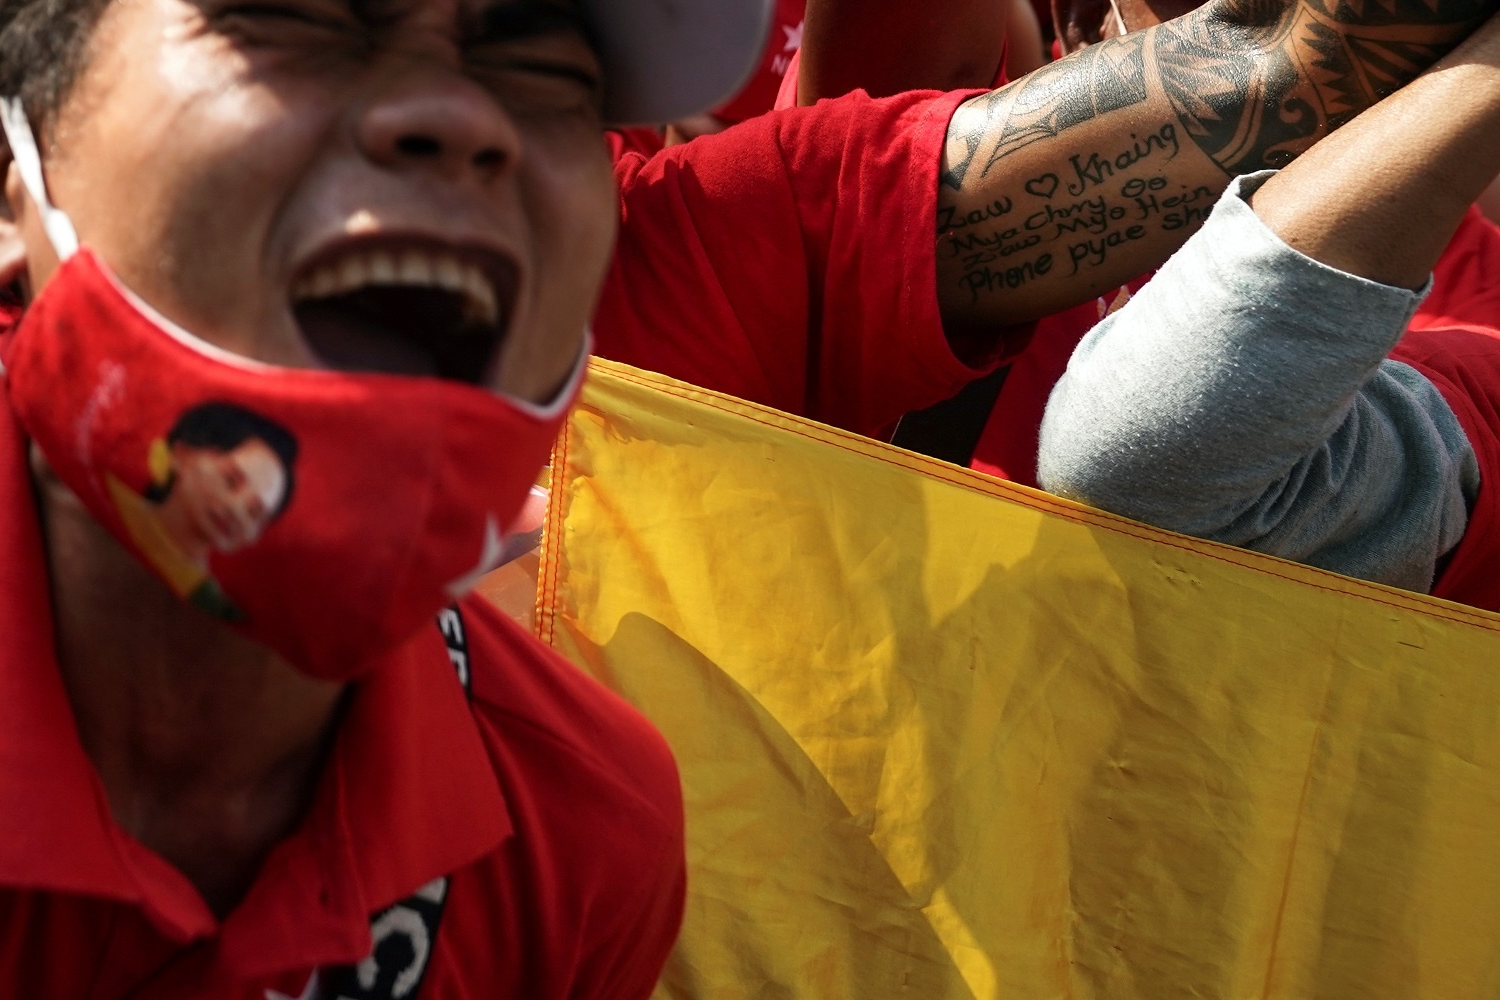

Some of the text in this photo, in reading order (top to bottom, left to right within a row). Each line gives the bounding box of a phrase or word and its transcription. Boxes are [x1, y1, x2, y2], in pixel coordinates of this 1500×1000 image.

[937, 123, 1180, 235] Zaw Khaing
[949, 228, 1020, 257] Mya
[962, 185, 1216, 271] Zaw Myo Hein
